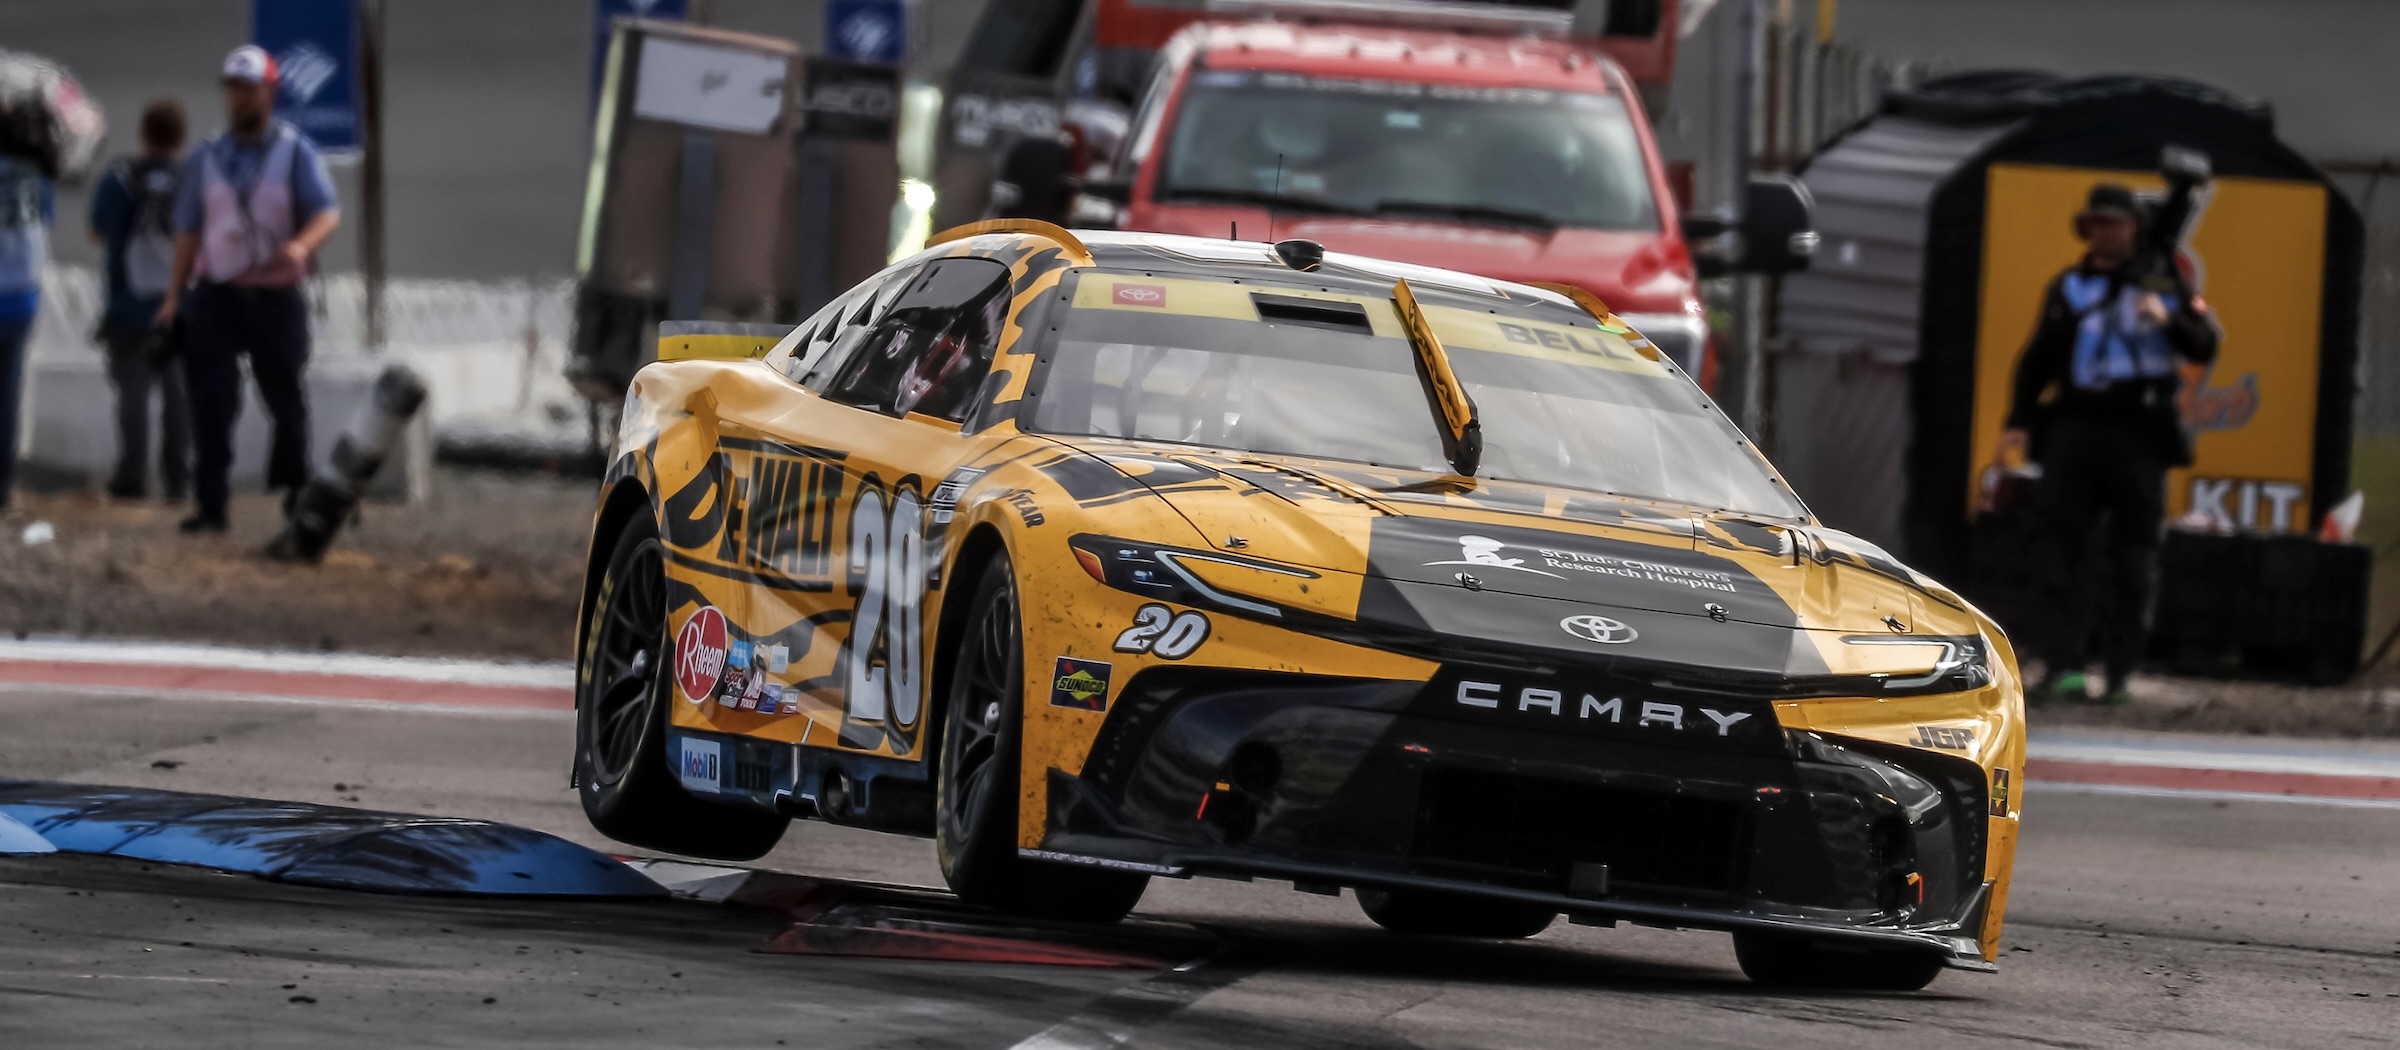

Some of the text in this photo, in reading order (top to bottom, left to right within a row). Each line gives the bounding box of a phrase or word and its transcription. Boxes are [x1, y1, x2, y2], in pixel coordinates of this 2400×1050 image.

[1497, 322, 1634, 362] BELL
[2192, 478, 2304, 536] KIT
[1538, 548, 1732, 583] St. Jude Children's
[1545, 557, 1738, 594] Research Hospital
[848, 484, 924, 733] 20
[1112, 602, 1212, 661] 20
[680, 609, 724, 687] Rheem
[1058, 676, 1106, 695] SUNOCO
[1457, 680, 1752, 737] CAMRY
[683, 750, 709, 779] Mobil
